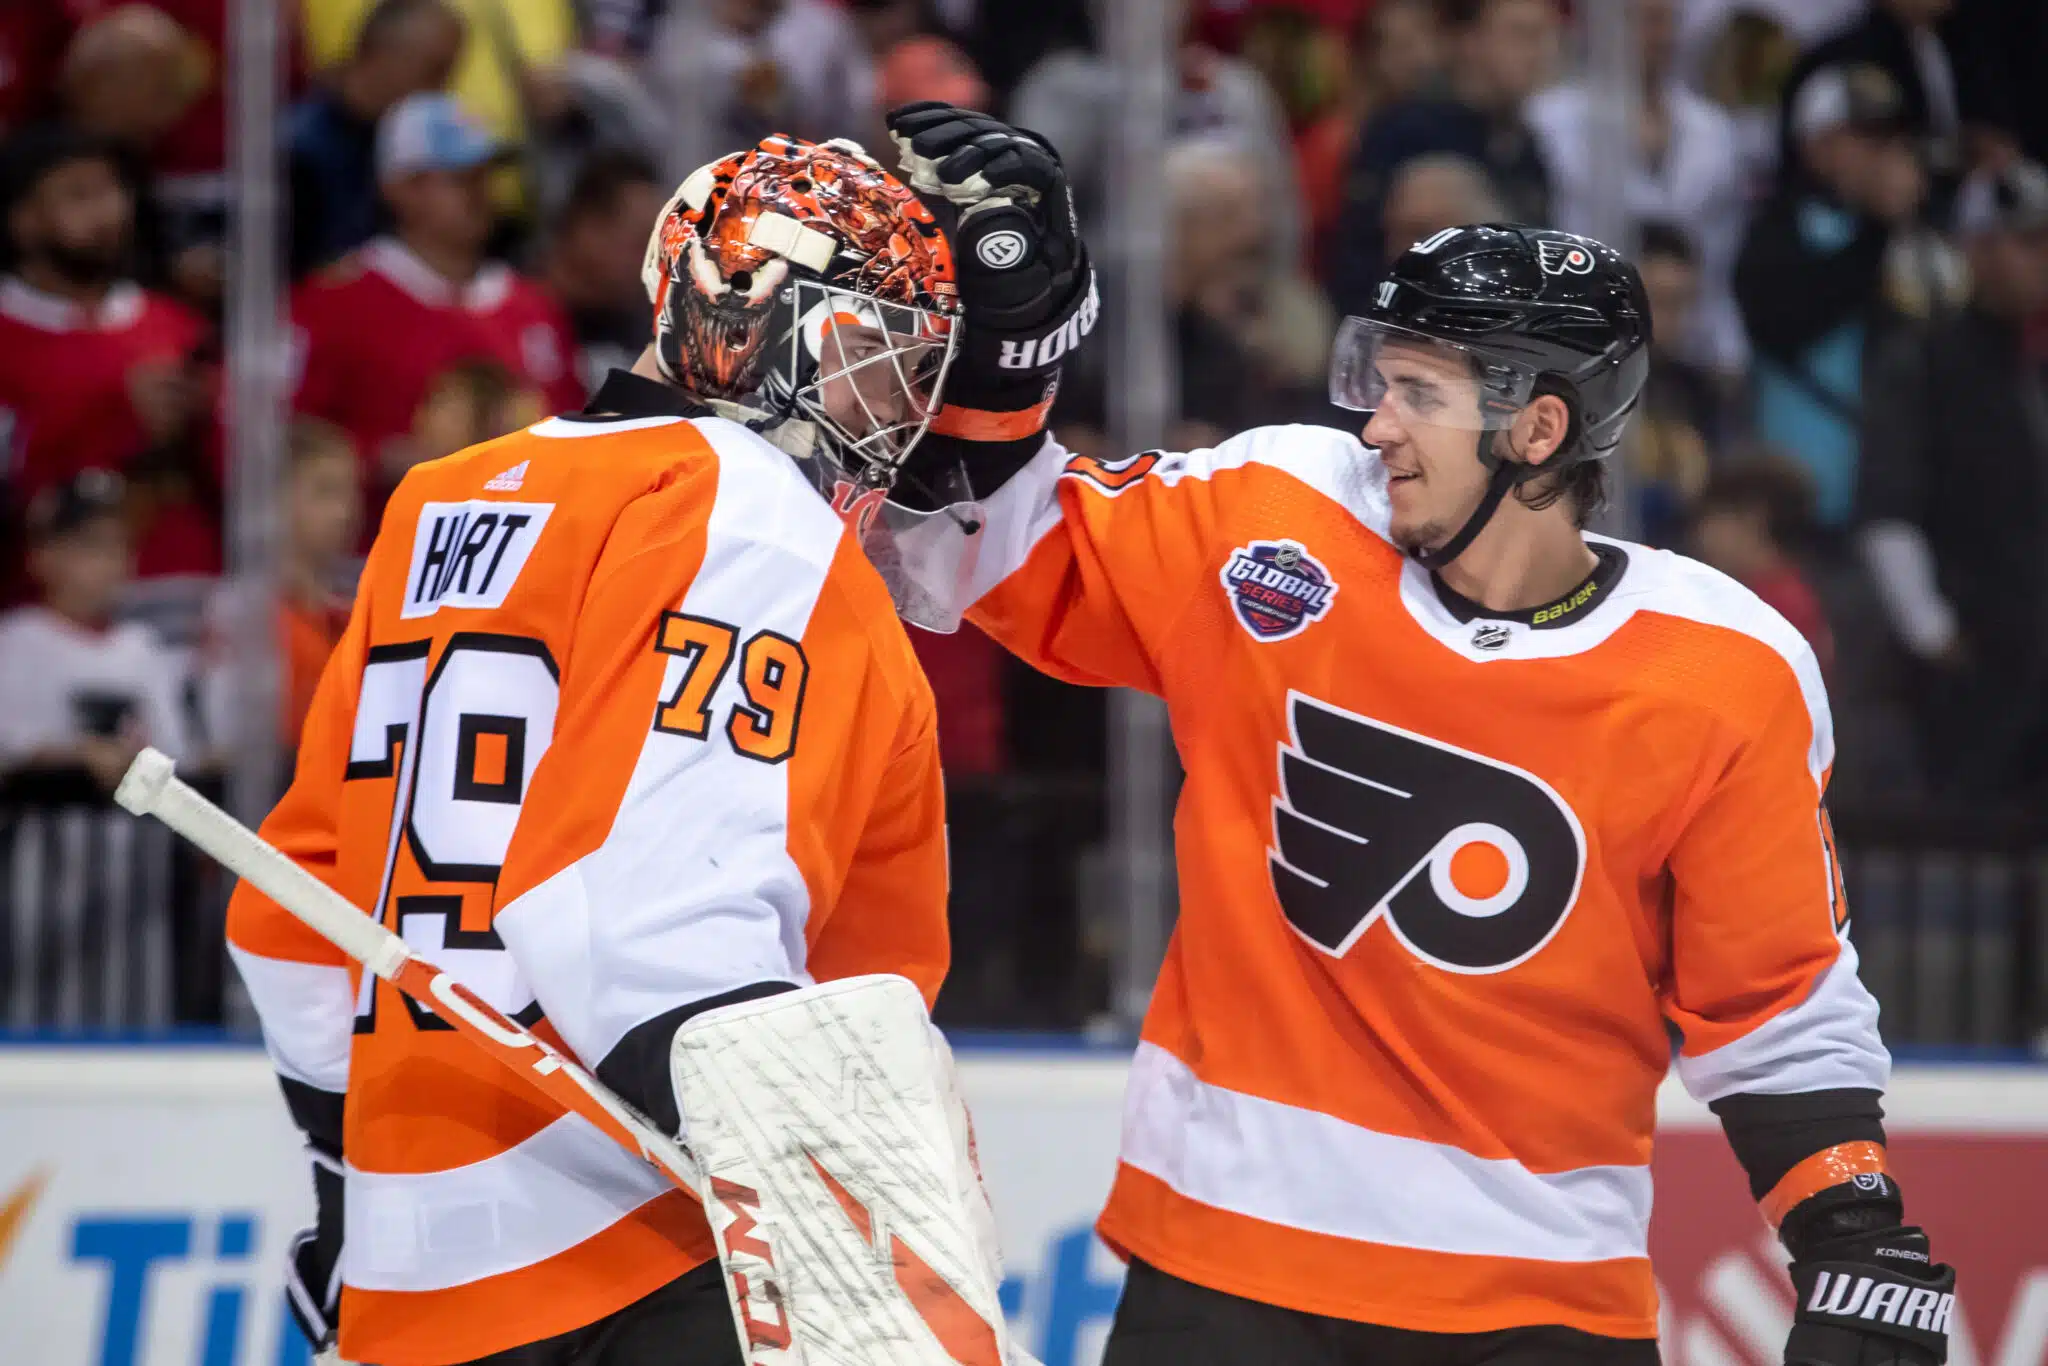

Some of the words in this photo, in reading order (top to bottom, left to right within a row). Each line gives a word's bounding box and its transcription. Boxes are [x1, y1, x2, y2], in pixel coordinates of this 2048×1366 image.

[999, 268, 1100, 369] RIOR
[414, 511, 532, 603] HRT
[1228, 557, 1329, 608] GLOBAL
[1239, 581, 1303, 613] SERIES
[653, 609, 809, 765] 79
[343, 631, 560, 1034] 79
[709, 1175, 793, 1366] CM
